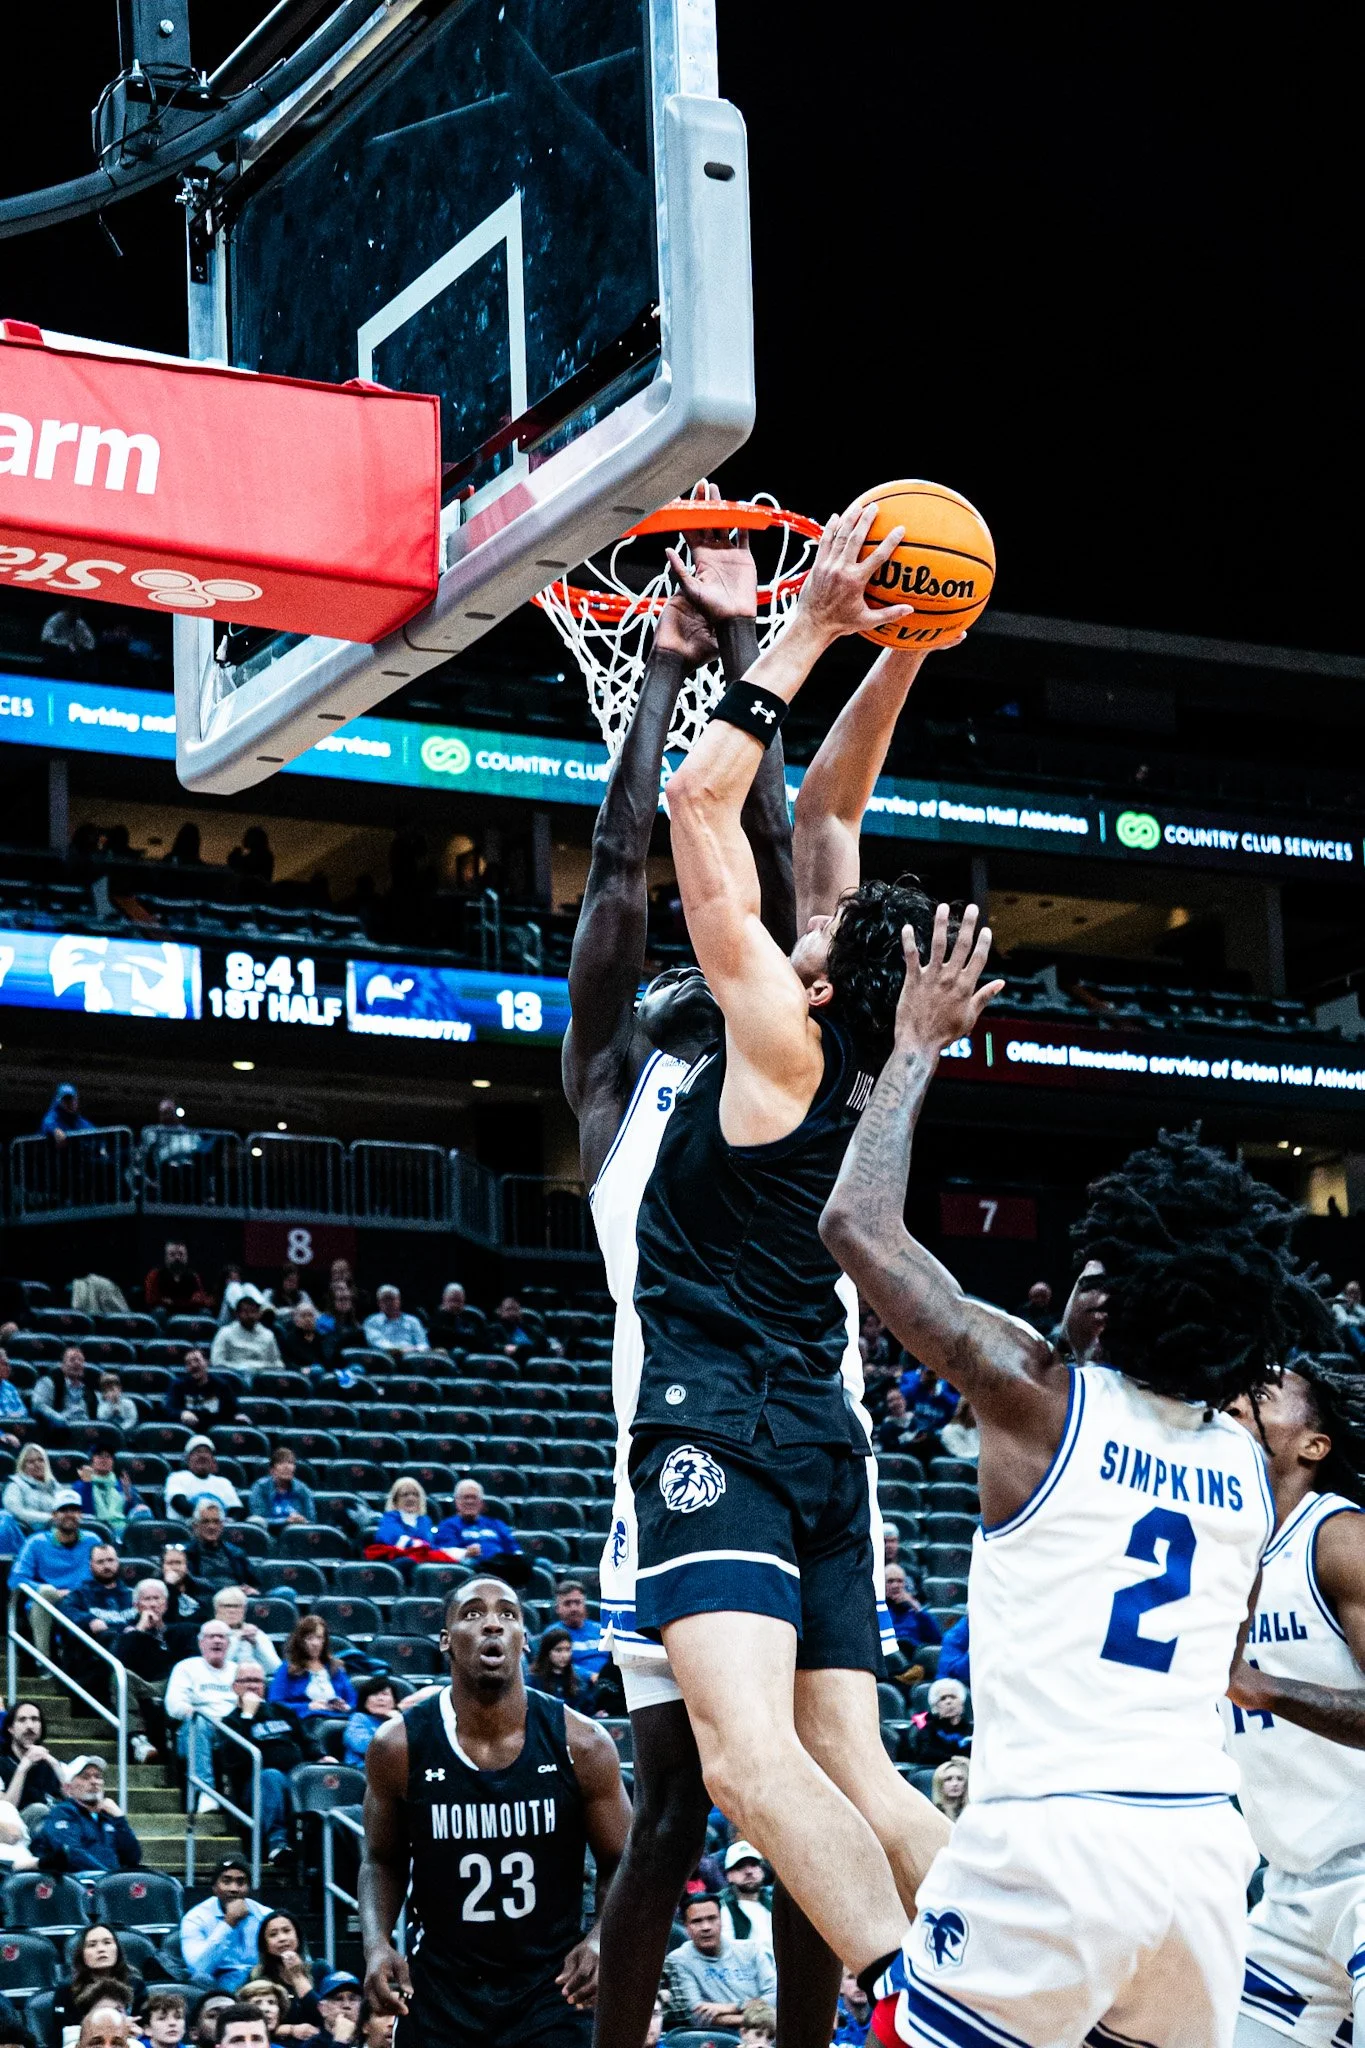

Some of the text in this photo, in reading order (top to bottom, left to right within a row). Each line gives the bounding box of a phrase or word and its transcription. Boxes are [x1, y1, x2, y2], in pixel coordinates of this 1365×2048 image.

[0, 412, 160, 495] arm
[869, 561, 975, 598] Wilson
[68, 702, 140, 733] Parking
[475, 750, 562, 777] COUNTRY
[919, 799, 937, 818] of
[938, 800, 986, 823] Seton
[986, 805, 1018, 827] Hall
[1019, 810, 1088, 835] Athletics
[1164, 824, 1353, 862] COUNTRY CLUB SERVICES
[225, 951, 315, 997] 8:41
[208, 987, 343, 1027] 1ST HALF
[496, 989, 543, 1032] 13
[1006, 1040, 1068, 1066] Official
[1068, 1045, 1149, 1073] limousine
[1149, 1055, 1209, 1078] service
[1211, 1058, 1230, 1080] of
[1231, 1059, 1279, 1084] Seton
[1280, 1063, 1313, 1086] Hall
[979, 1200, 998, 1233] 7
[287, 1228, 314, 1265] 8
[1100, 1440, 1243, 1512] SIMPKINS
[1100, 1506, 1197, 1673] 2
[1247, 1611, 1308, 1644] HALL
[431, 1798, 556, 1840] MONMOUTH
[459, 1851, 537, 1922] 23
